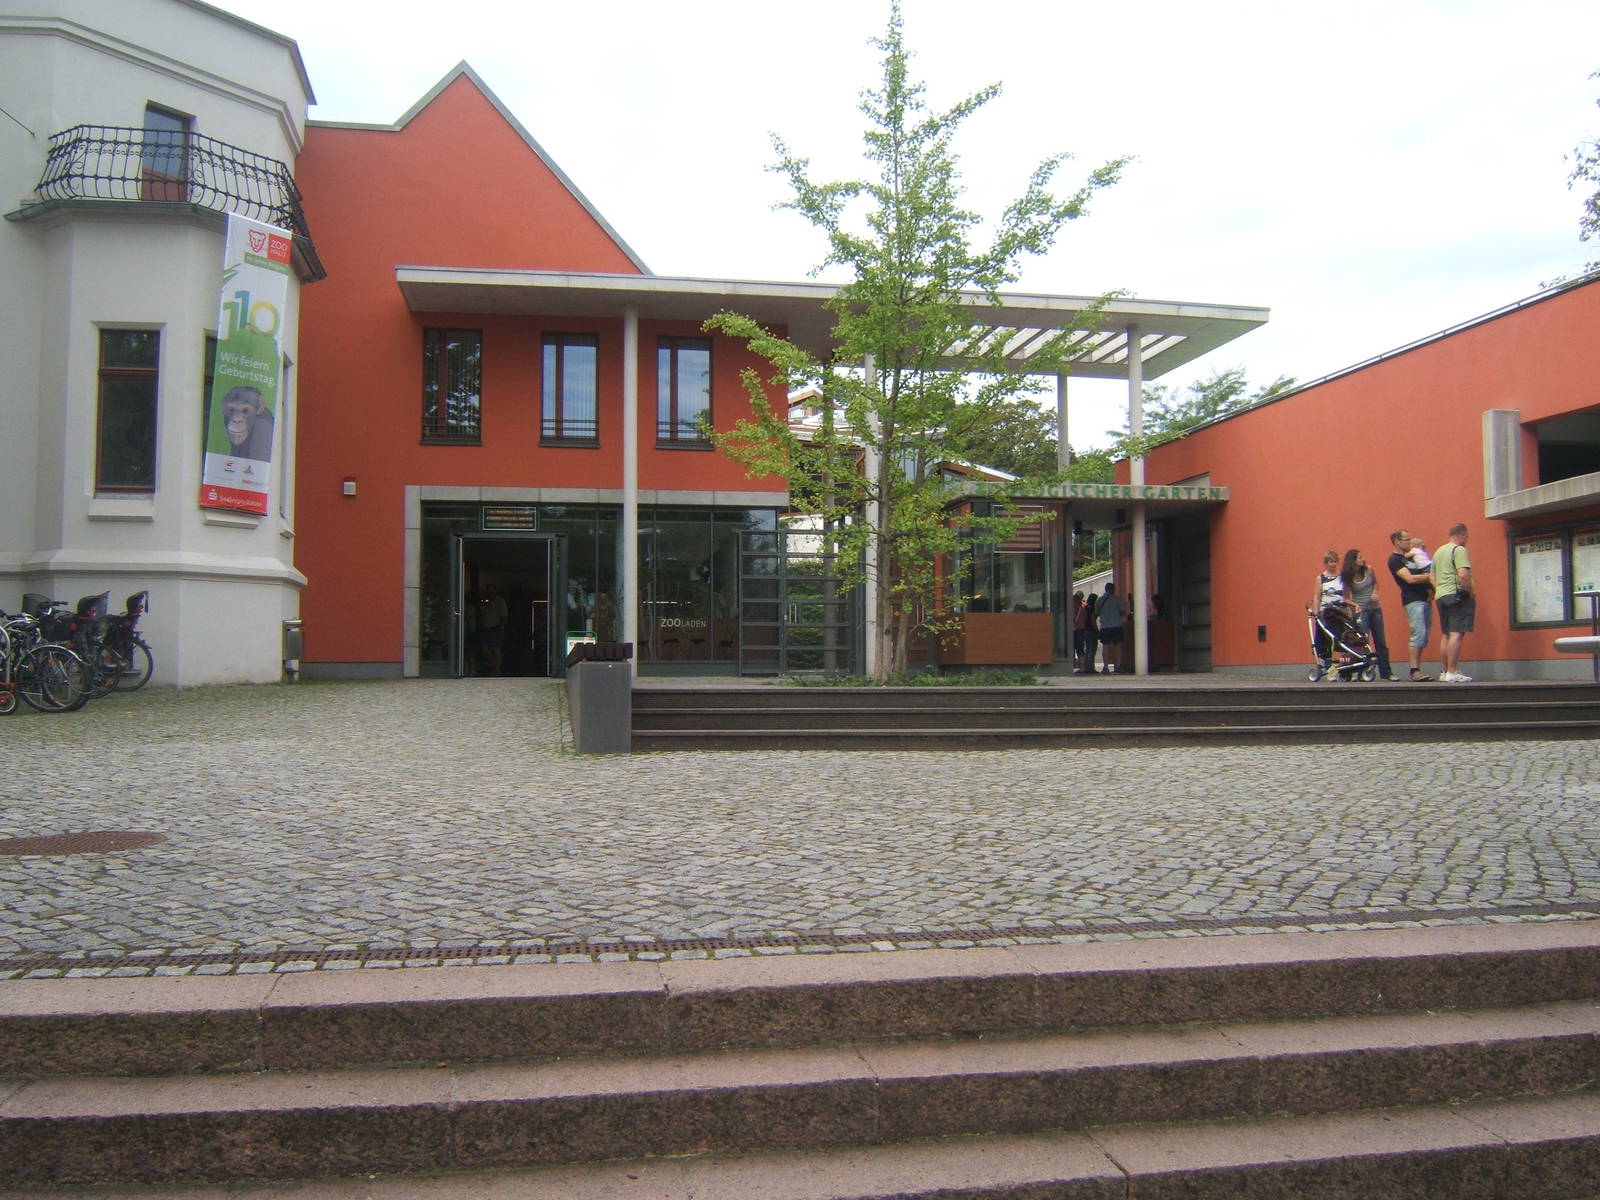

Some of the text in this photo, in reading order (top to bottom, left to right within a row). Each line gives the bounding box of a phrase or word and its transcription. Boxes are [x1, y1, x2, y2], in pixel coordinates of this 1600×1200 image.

[271, 239, 288, 251] ZOO
[223, 290, 280, 338] 110
[221, 351, 270, 371] Wir feiern
[1142, 487, 1220, 500] GARTEN
